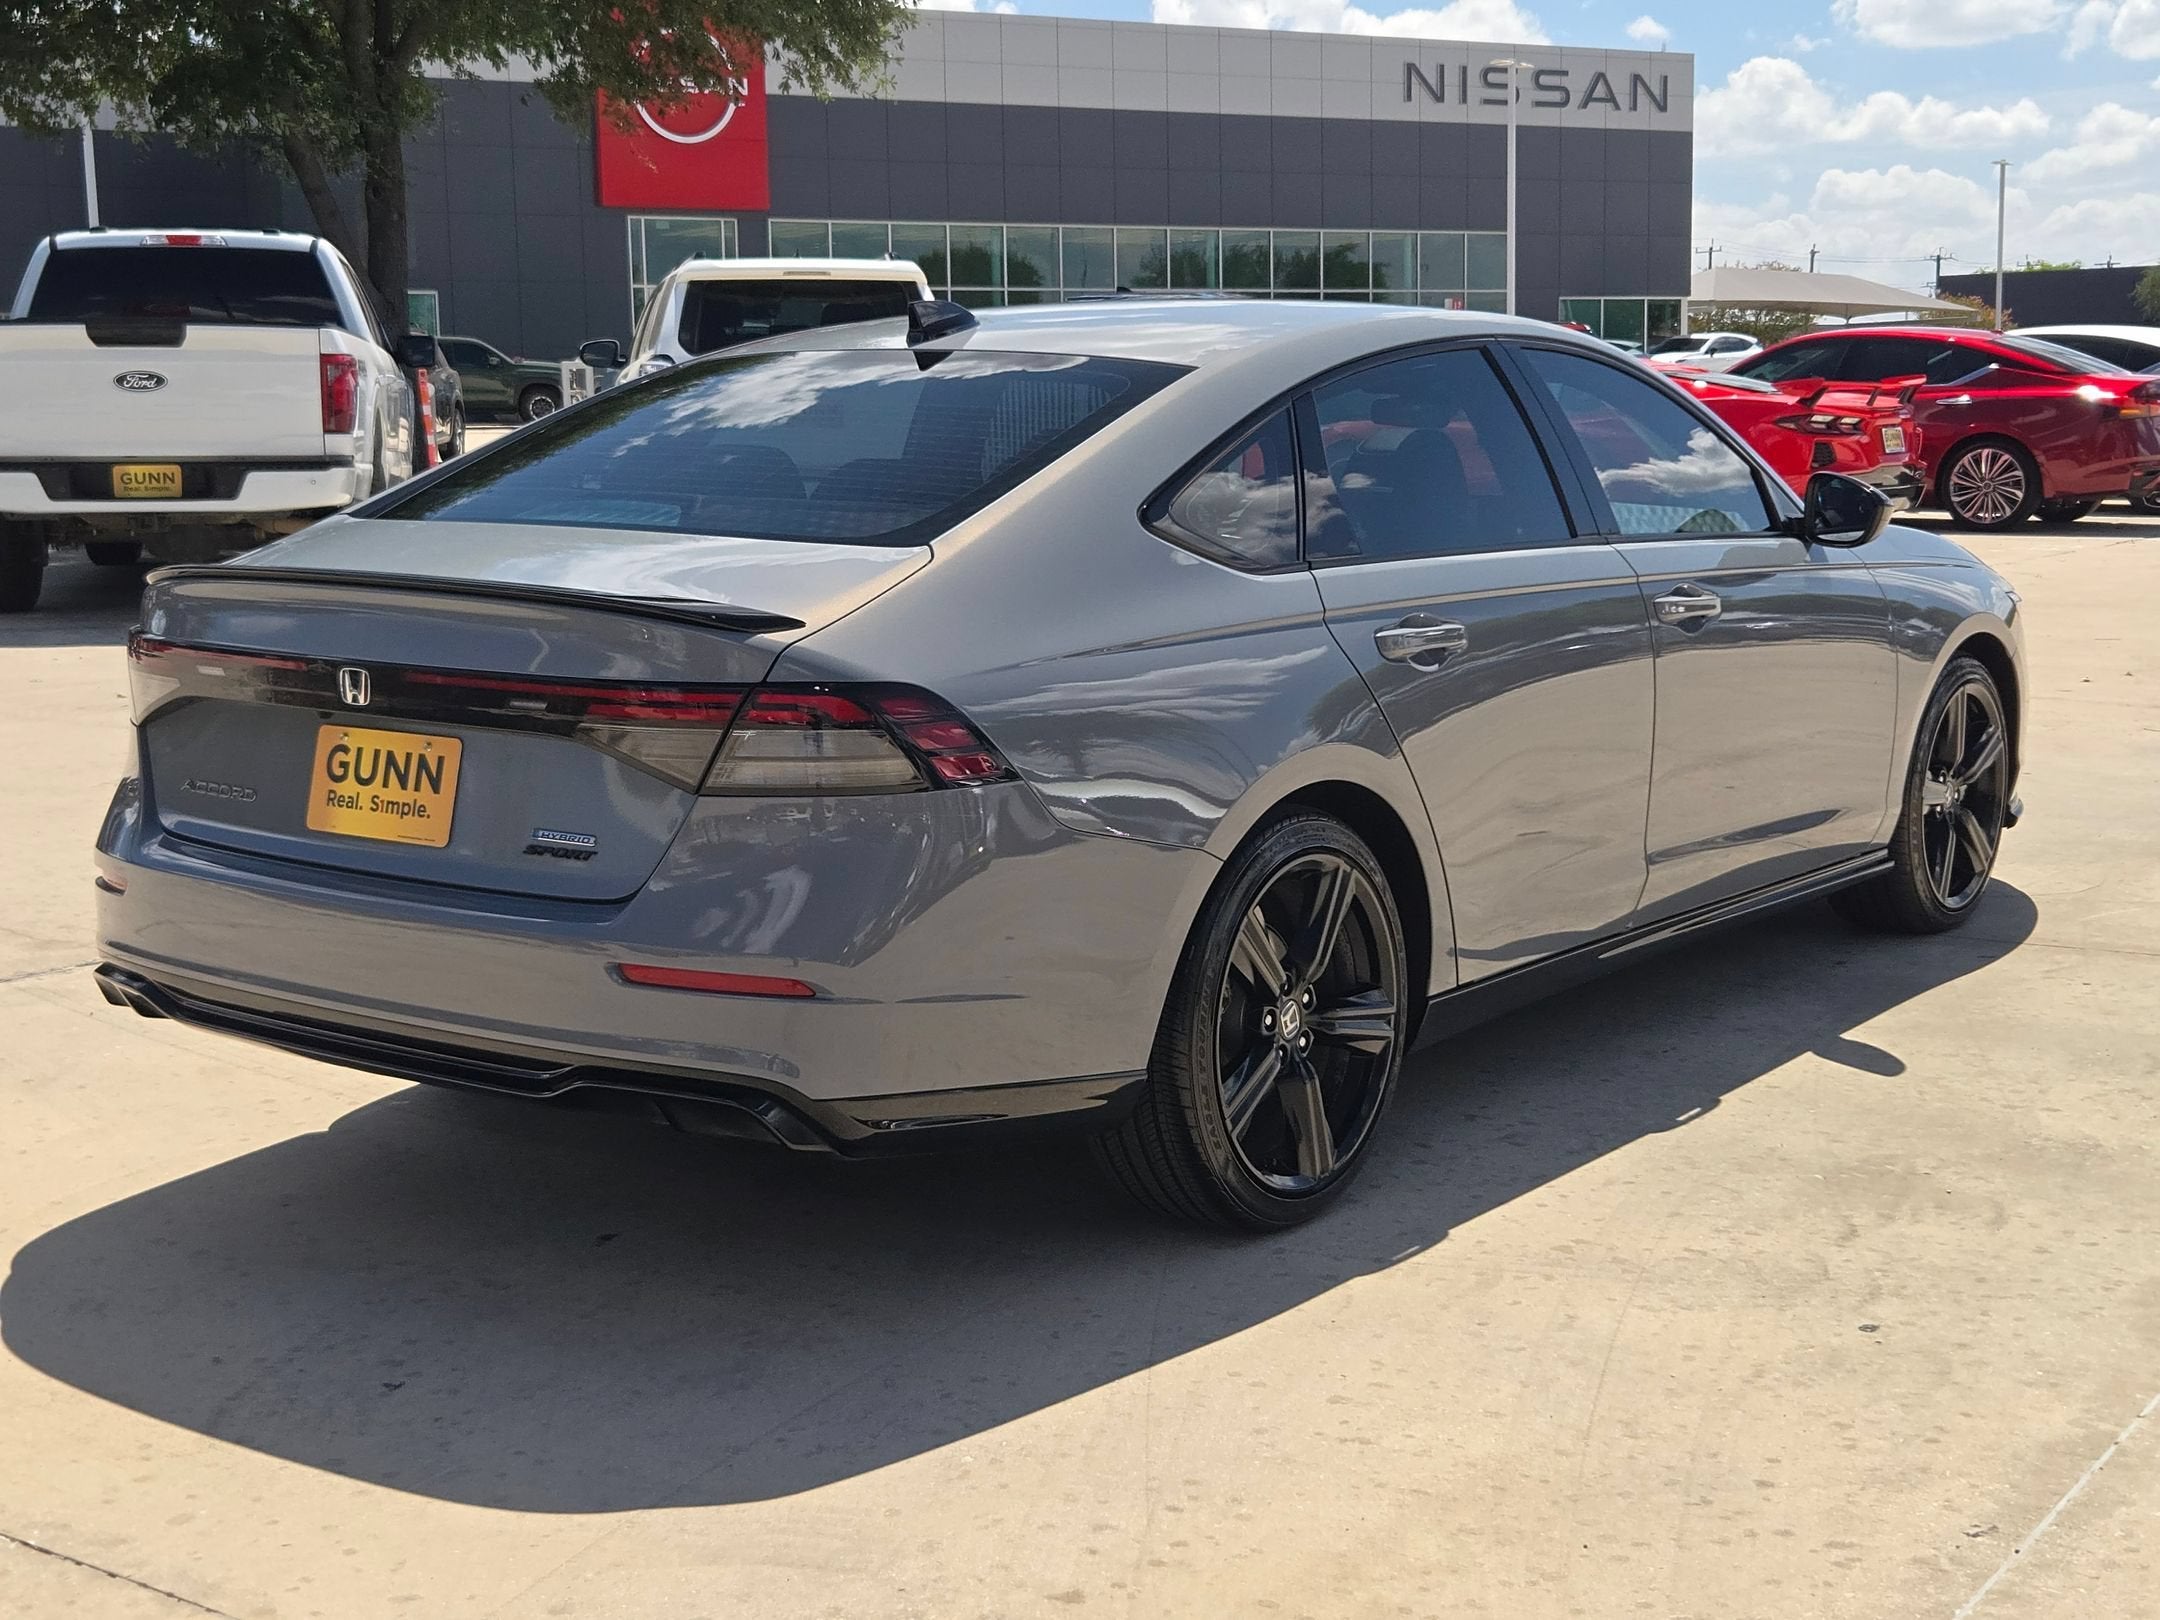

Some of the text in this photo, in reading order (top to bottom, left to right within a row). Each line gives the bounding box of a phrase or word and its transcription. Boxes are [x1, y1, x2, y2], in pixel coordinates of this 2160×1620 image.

[1403, 61, 1669, 113] NISSAN
[123, 374, 158, 388] Ford
[120, 472, 176, 485] GUNN
[326, 743, 446, 795] GUNN
[180, 779, 257, 802] ACCORD
[326, 789, 363, 811] Real.
[541, 831, 592, 844] HYBRID
[522, 844, 599, 861] SPORT
